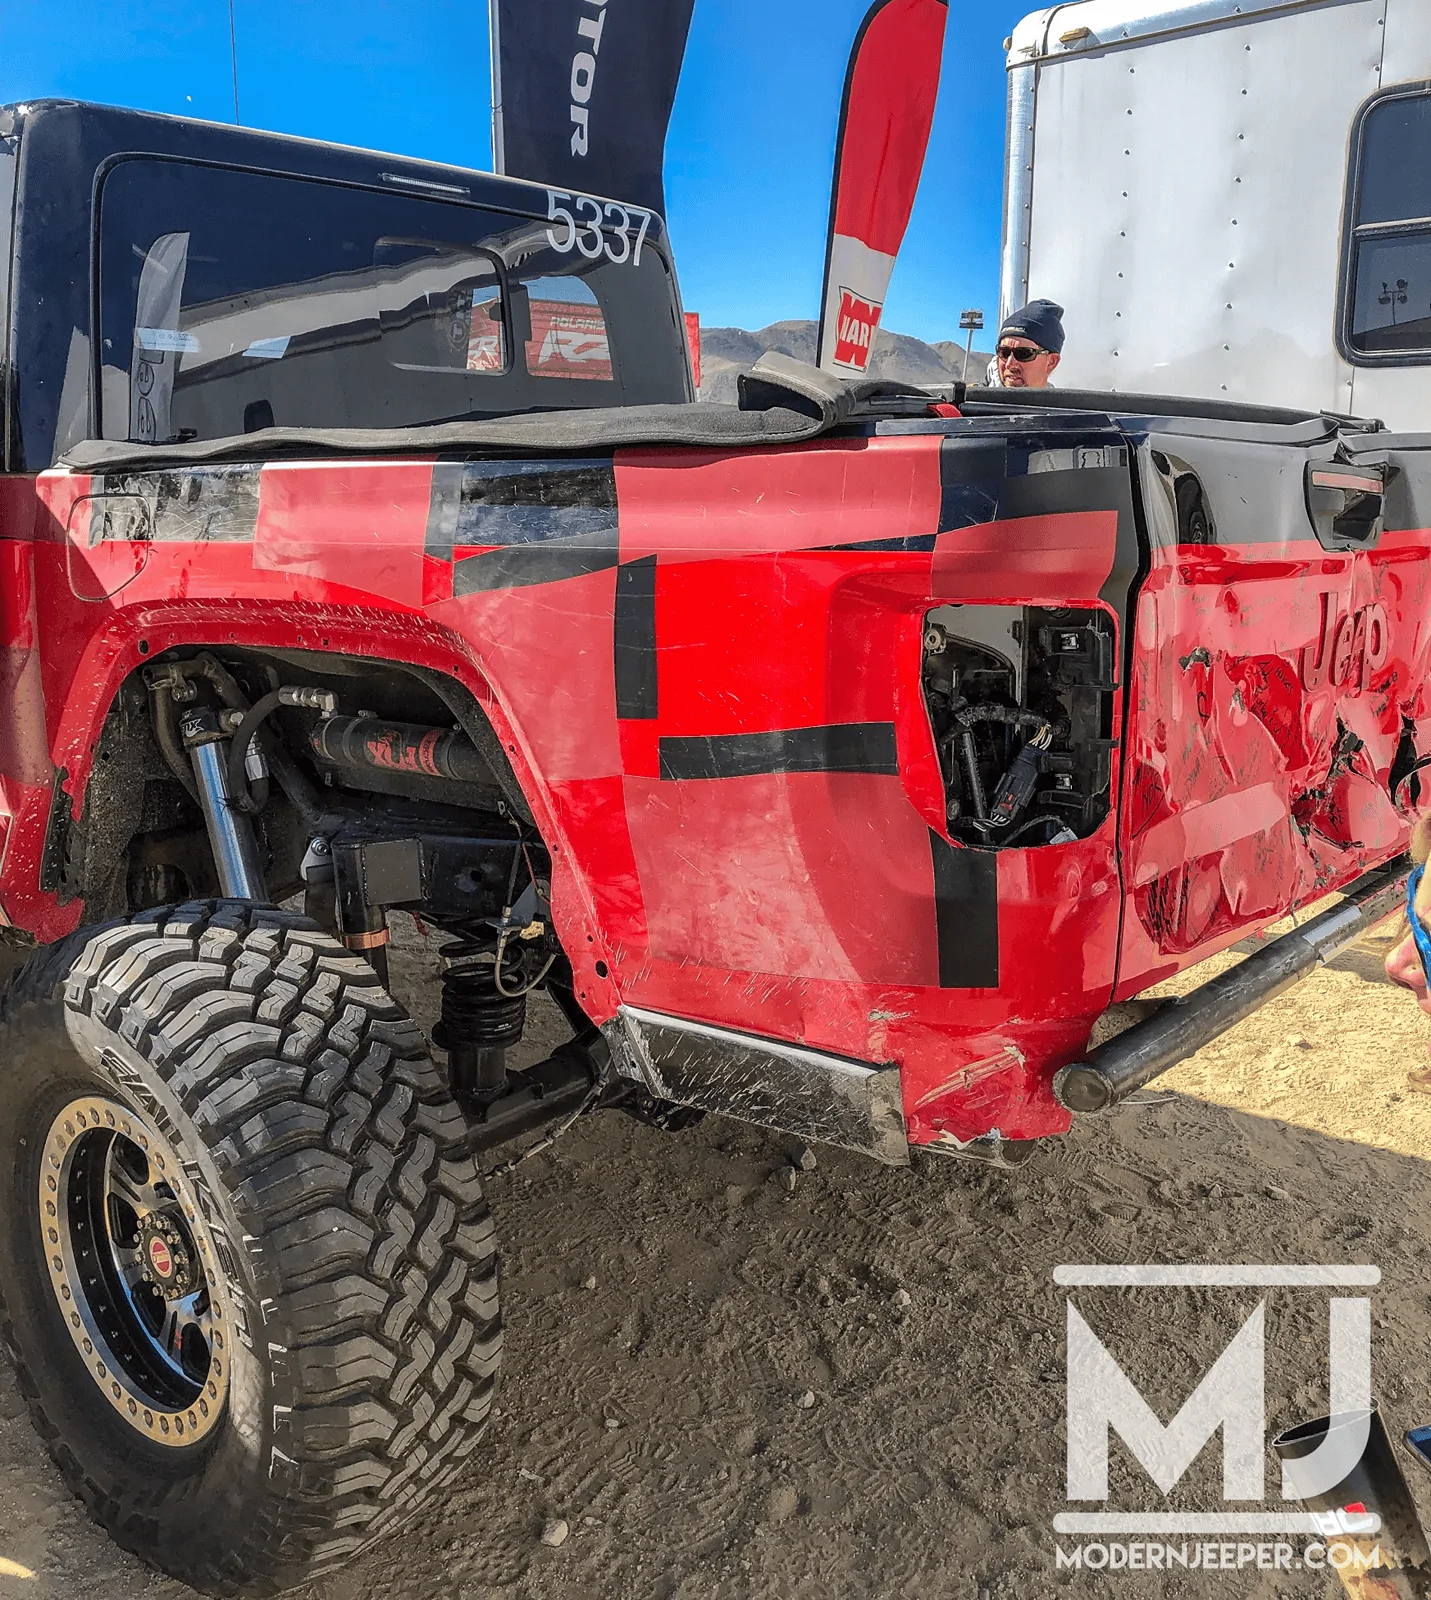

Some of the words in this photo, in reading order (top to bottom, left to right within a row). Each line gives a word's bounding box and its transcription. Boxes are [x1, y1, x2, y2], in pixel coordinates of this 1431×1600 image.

[570, 0, 608, 156] TOR
[546, 189, 651, 267] 5337
[1298, 591, 1388, 693] Jeep
